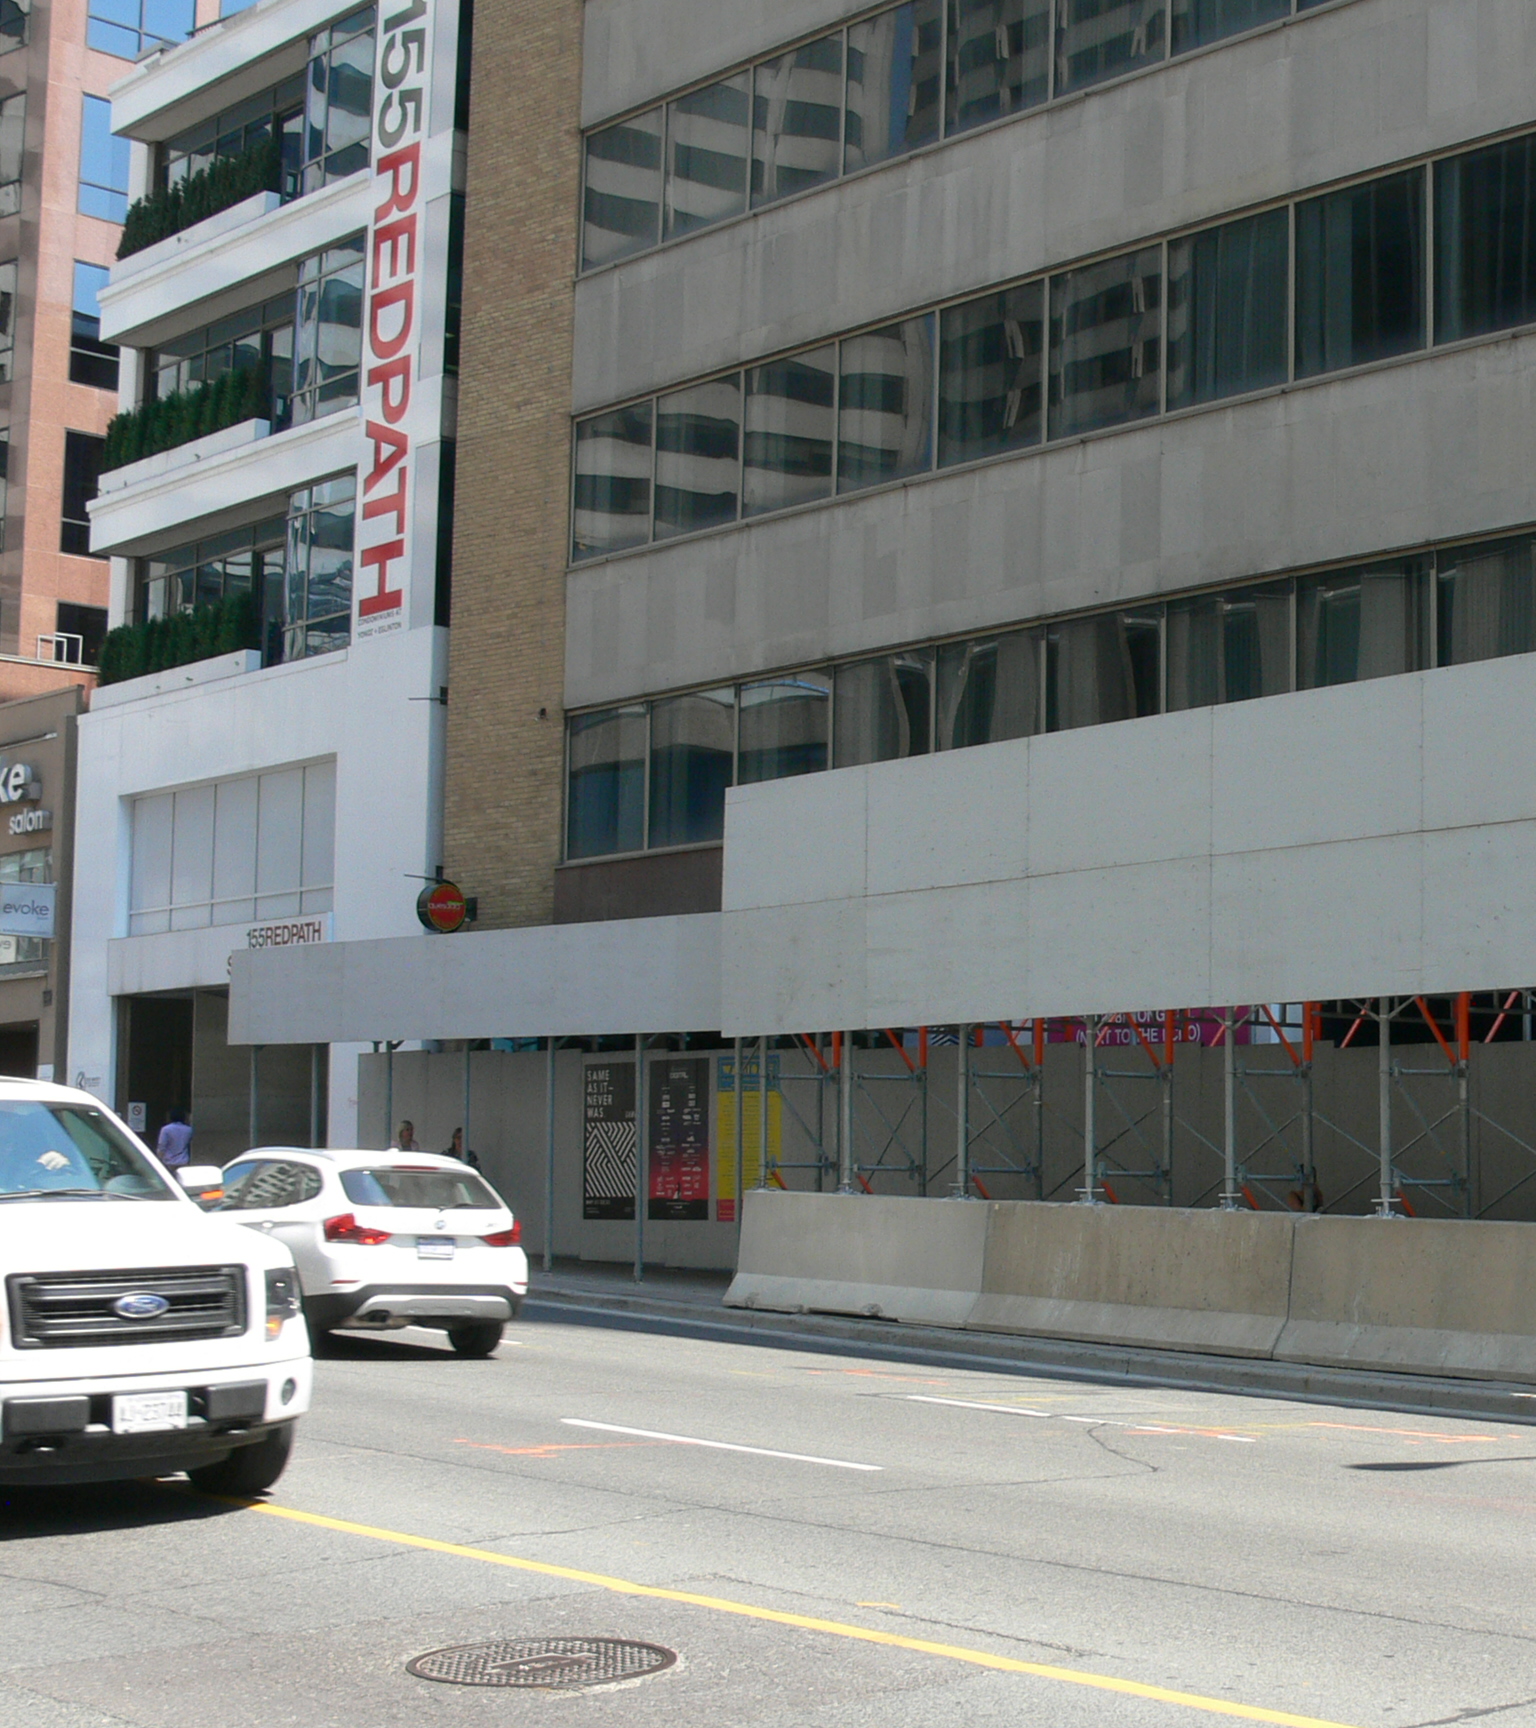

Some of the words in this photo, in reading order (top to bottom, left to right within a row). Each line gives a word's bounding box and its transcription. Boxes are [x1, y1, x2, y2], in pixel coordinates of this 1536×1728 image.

[9, 808, 43, 835] salon
[3, 900, 49, 916] evoke
[246, 921, 322, 949] 155REDPATH
[1115, 1029, 1131, 1043] TO
[587, 1069, 610, 1081] SAME
[587, 1083, 598, 1093] AS
[587, 1094, 613, 1106] NEVER
